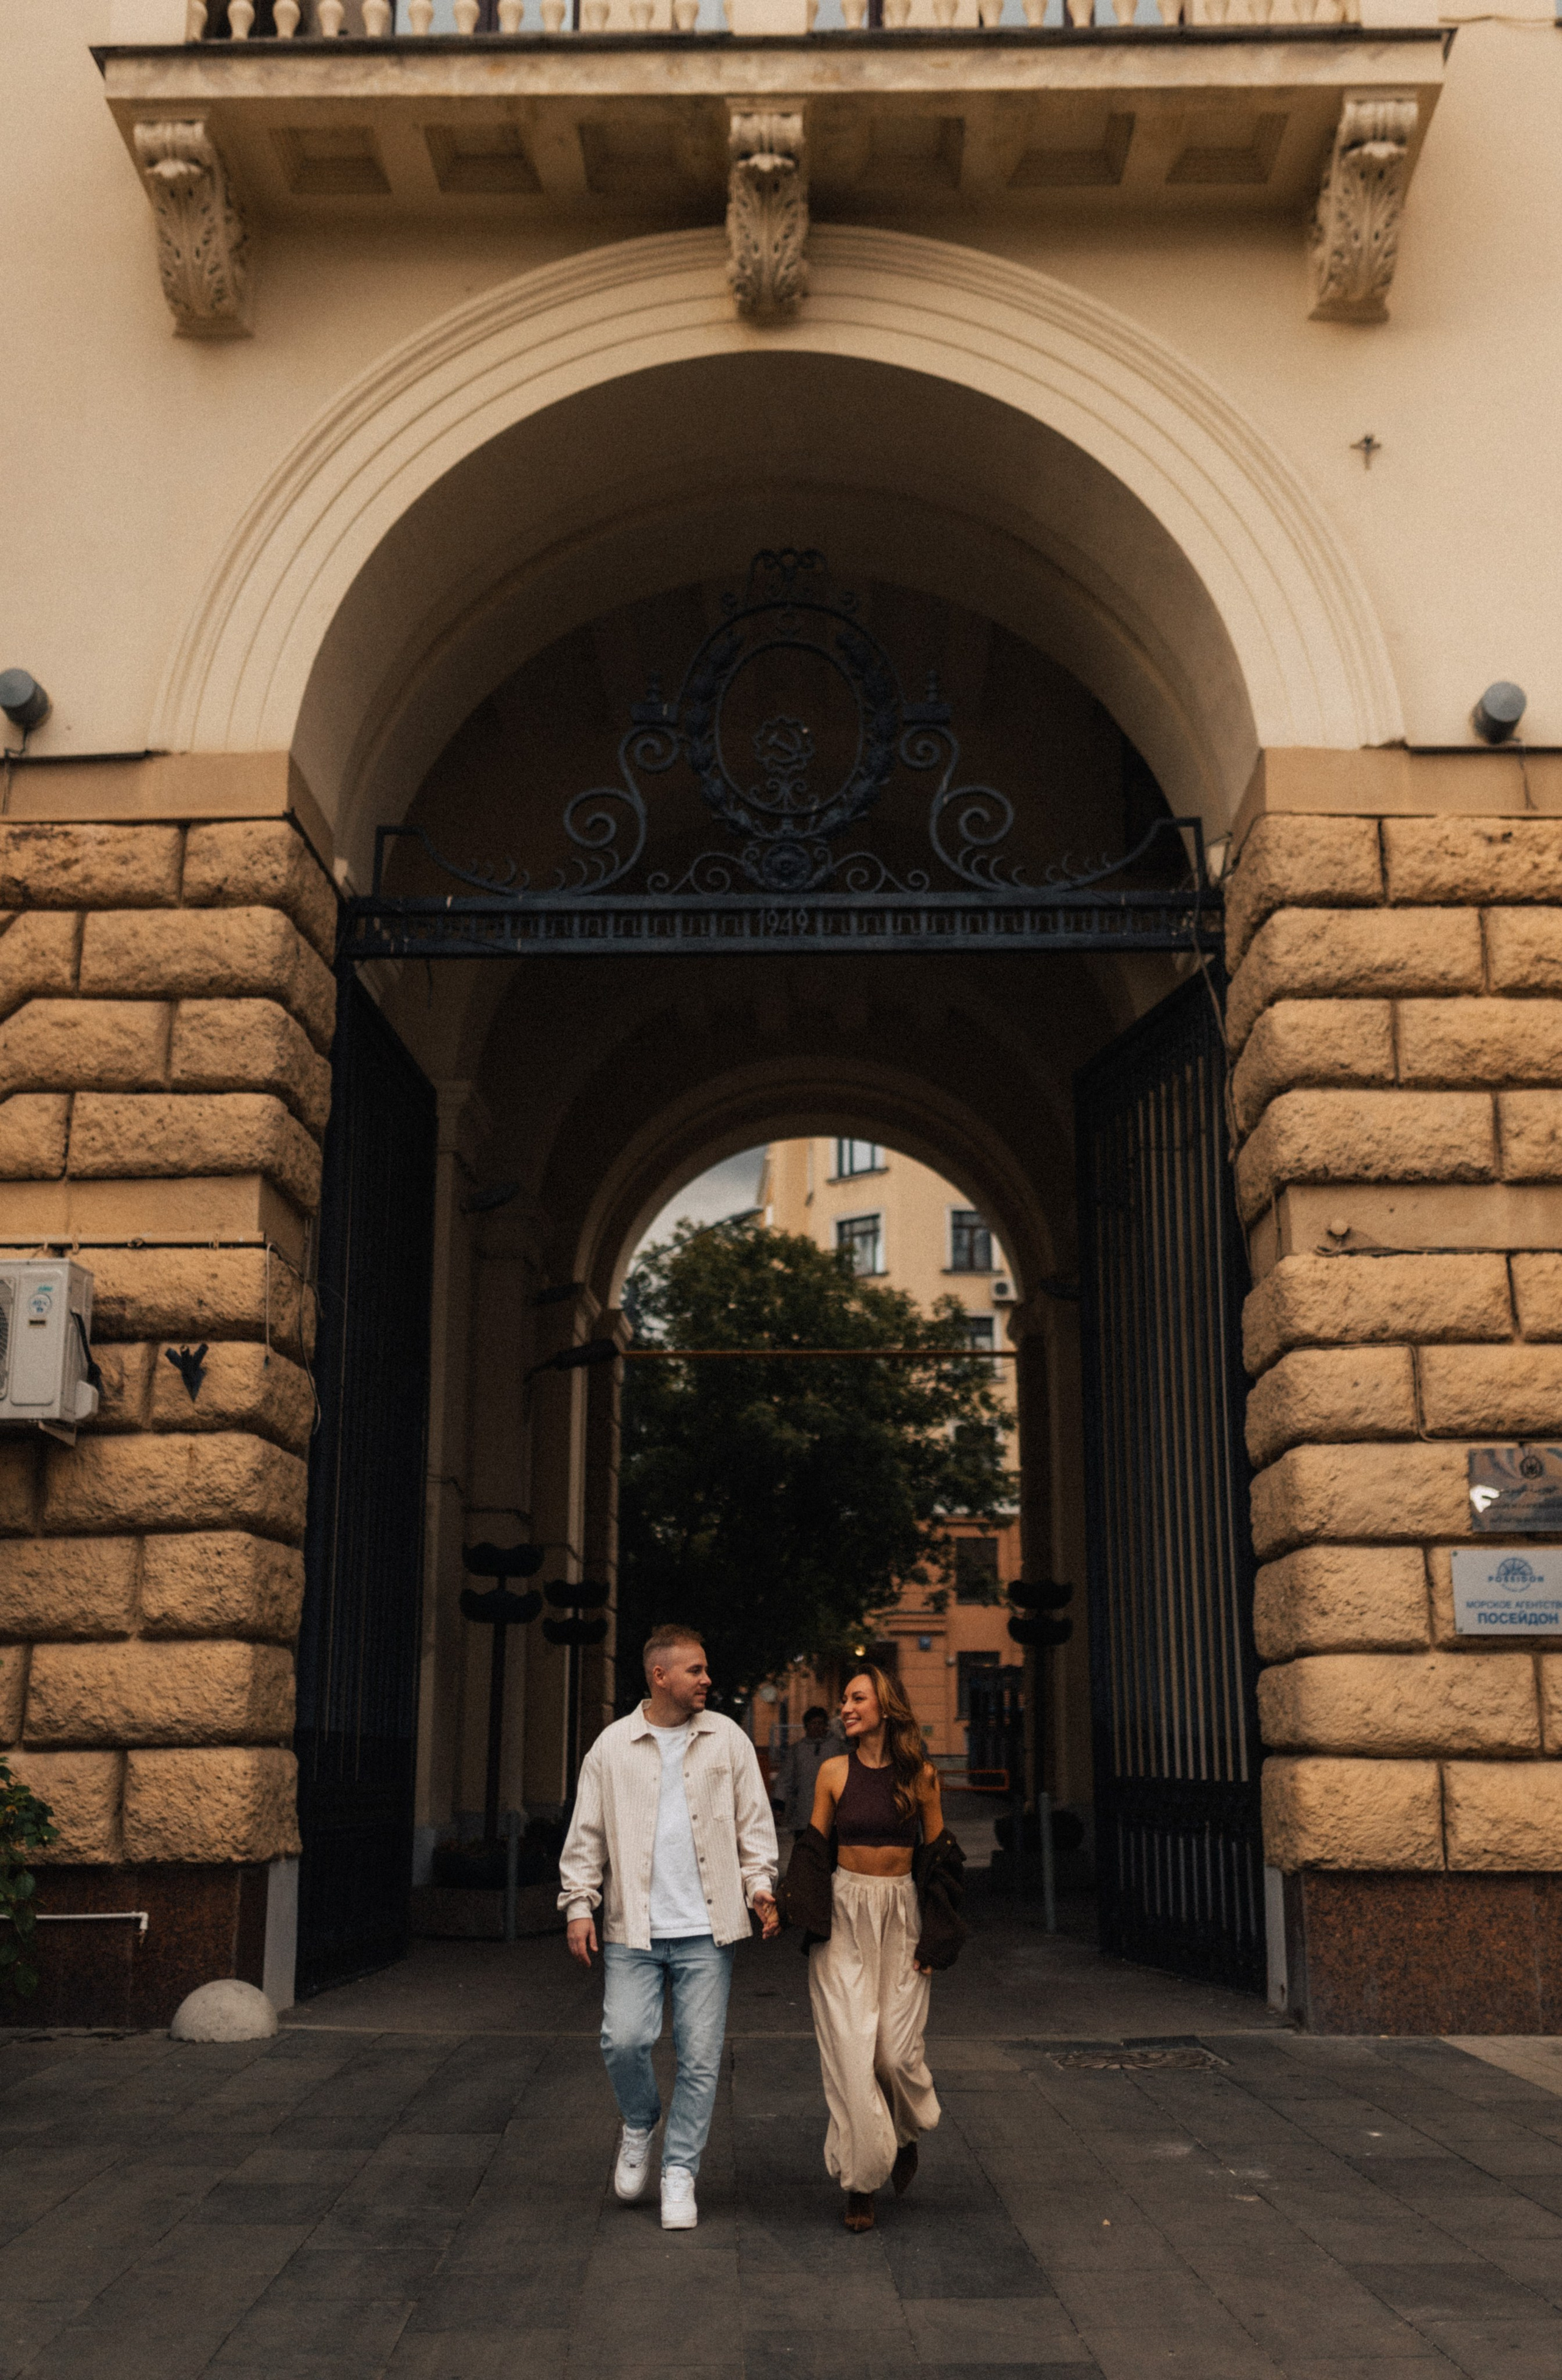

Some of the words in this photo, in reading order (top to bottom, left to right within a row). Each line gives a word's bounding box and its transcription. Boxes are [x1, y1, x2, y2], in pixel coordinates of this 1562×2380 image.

[758, 908, 809, 936] 1949
[1466, 1600, 1511, 1609] МОРСКОЕ
[1477, 1610, 1559, 1627] ПОСЕЙДОН
